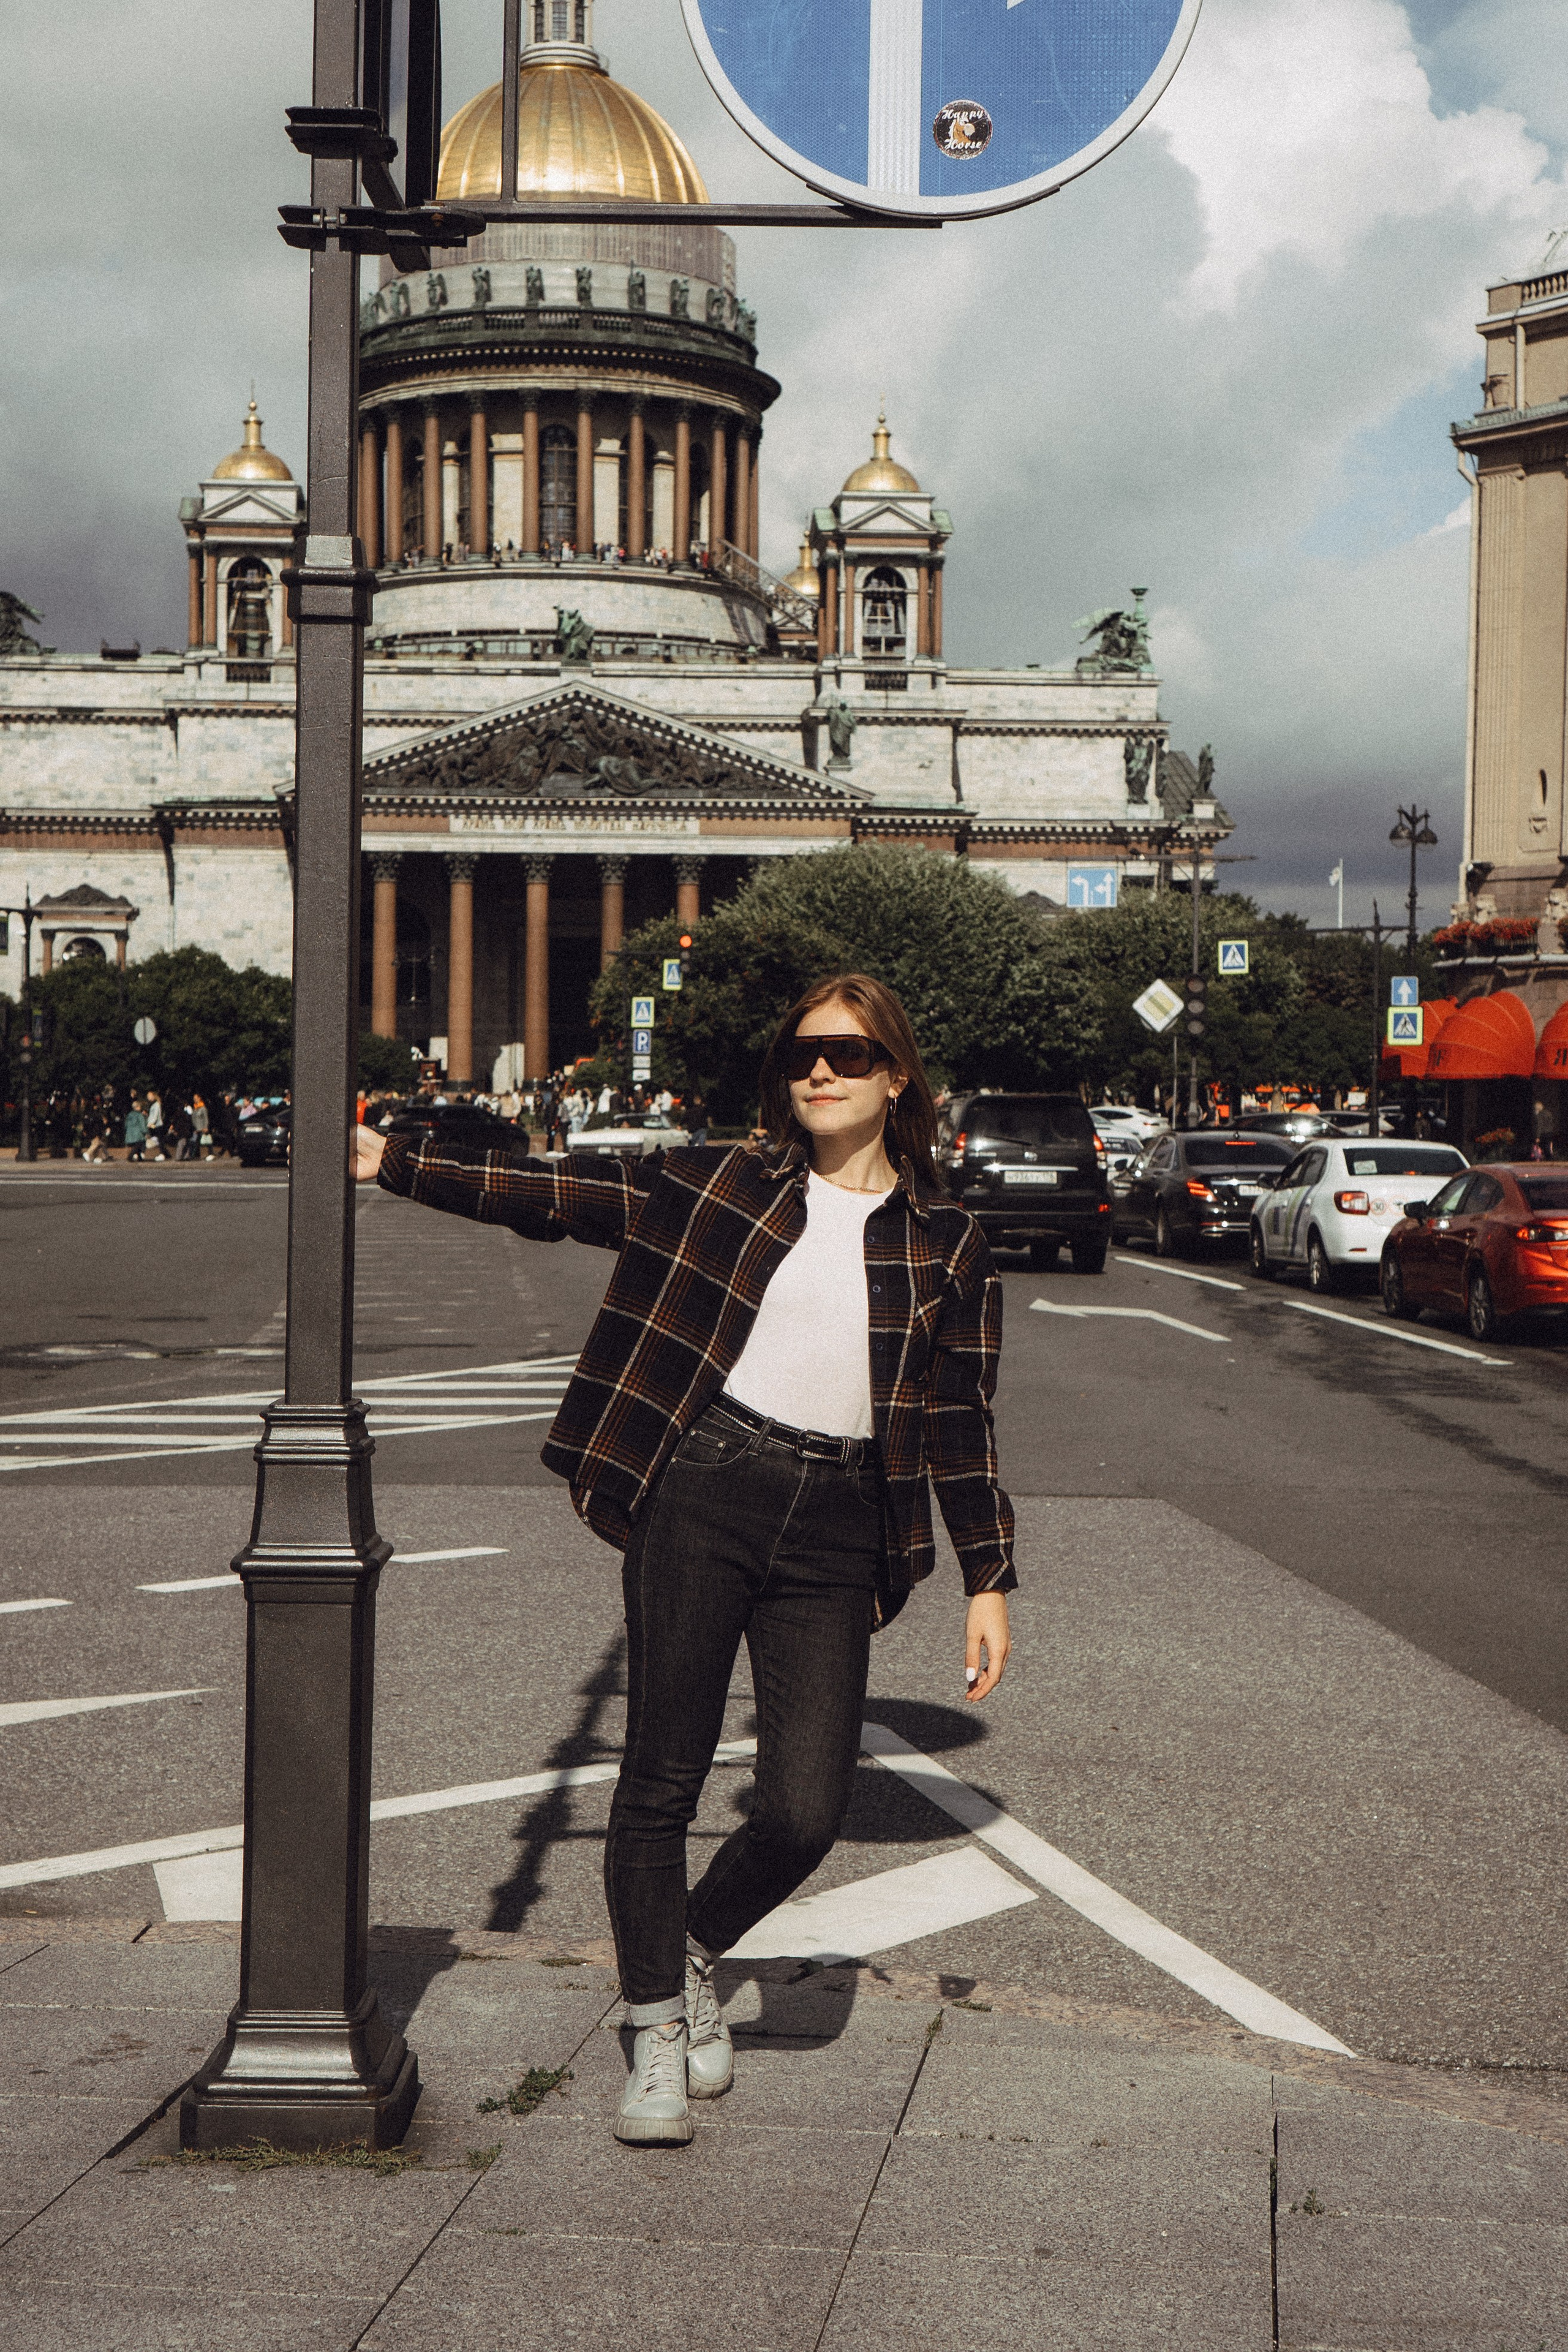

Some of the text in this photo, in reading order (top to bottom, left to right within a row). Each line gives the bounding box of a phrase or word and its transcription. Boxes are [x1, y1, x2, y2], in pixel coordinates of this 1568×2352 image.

[941, 109, 984, 119] Happy
[944, 138, 982, 149] Horse
[637, 1031, 648, 1051] P
